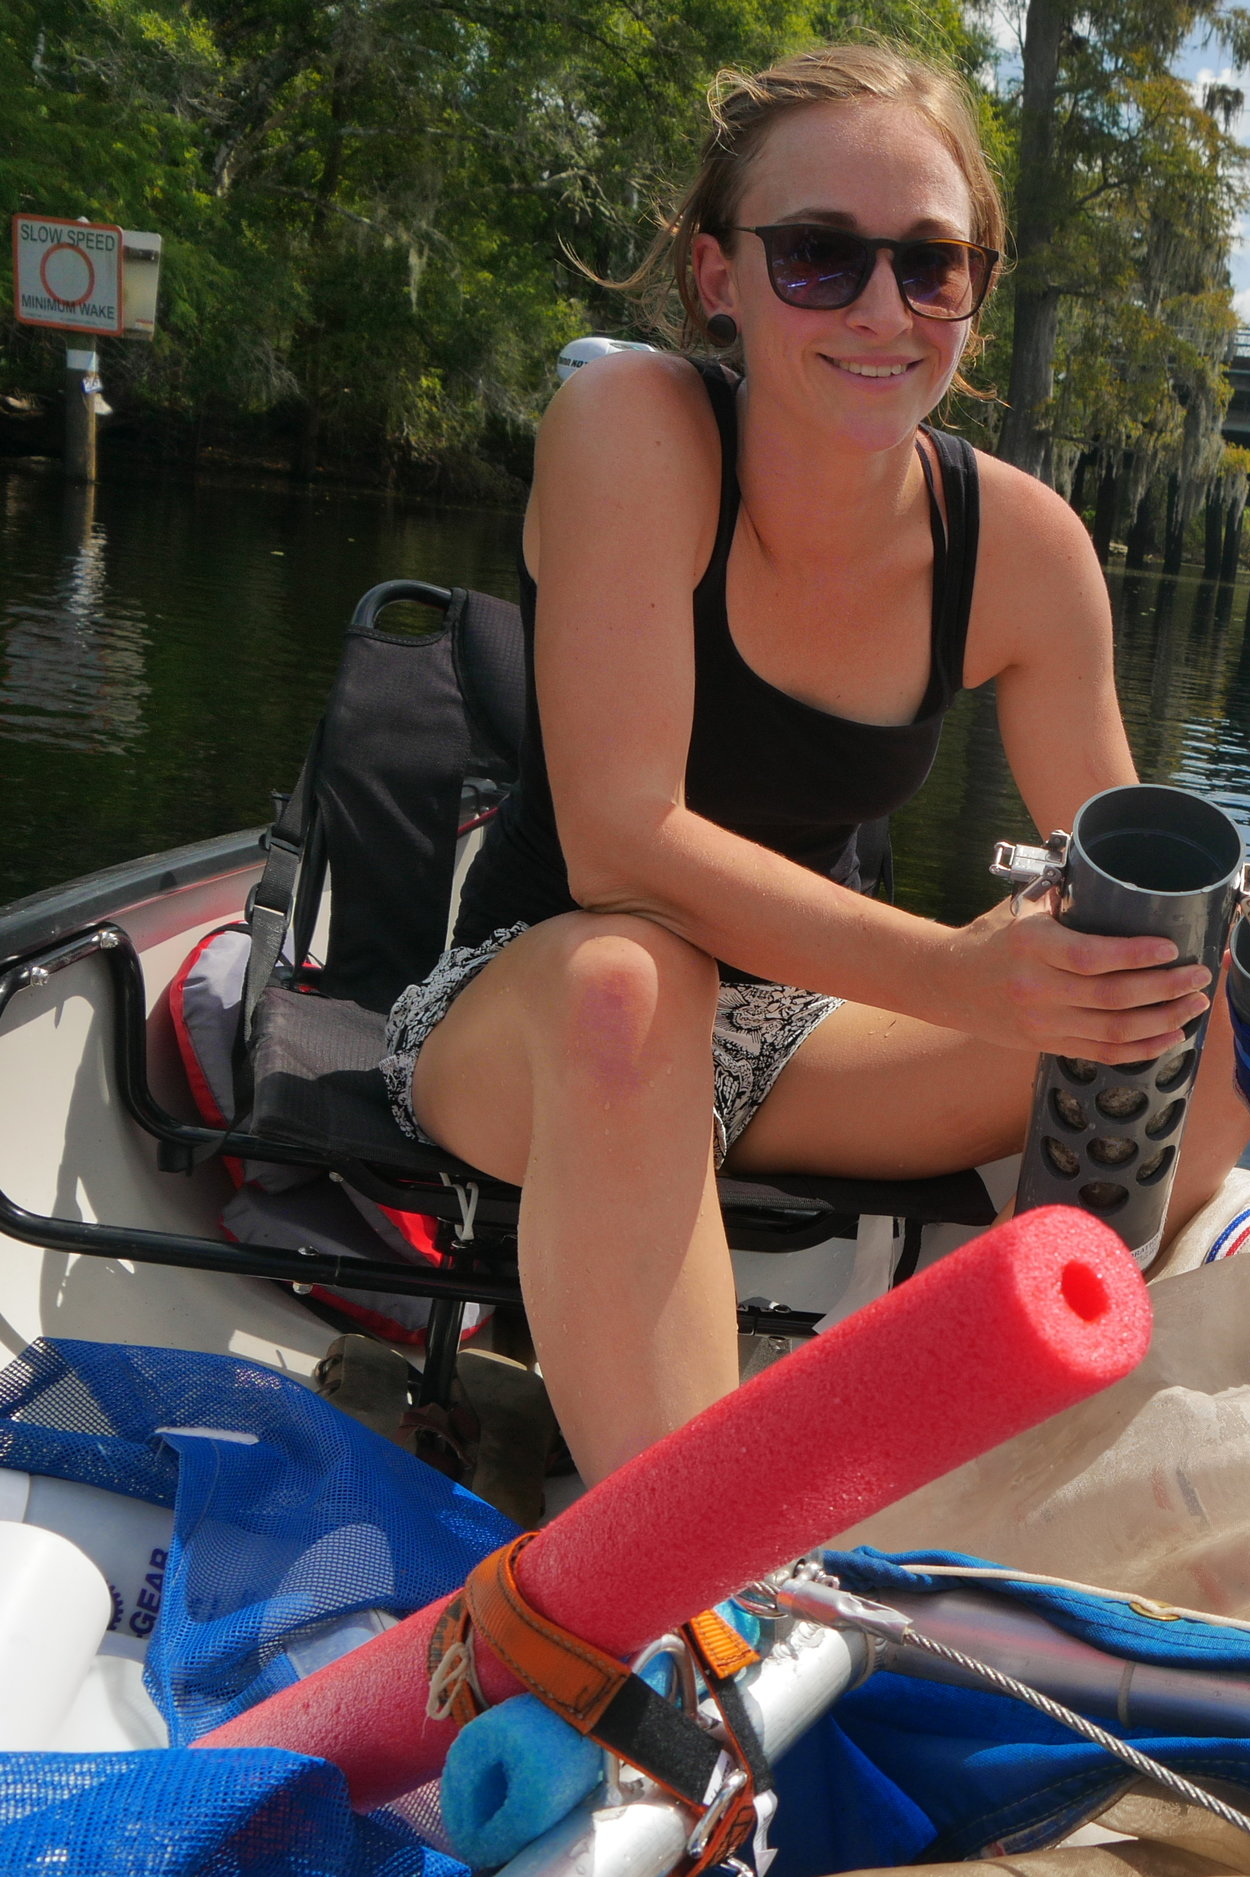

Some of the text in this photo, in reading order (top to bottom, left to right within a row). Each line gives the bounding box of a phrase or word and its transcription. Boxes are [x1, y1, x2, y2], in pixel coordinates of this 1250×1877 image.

[20, 223, 115, 252] SLOW SPEED
[21, 294, 76, 314] MINIMUM
[79, 303, 115, 320] WAKE
